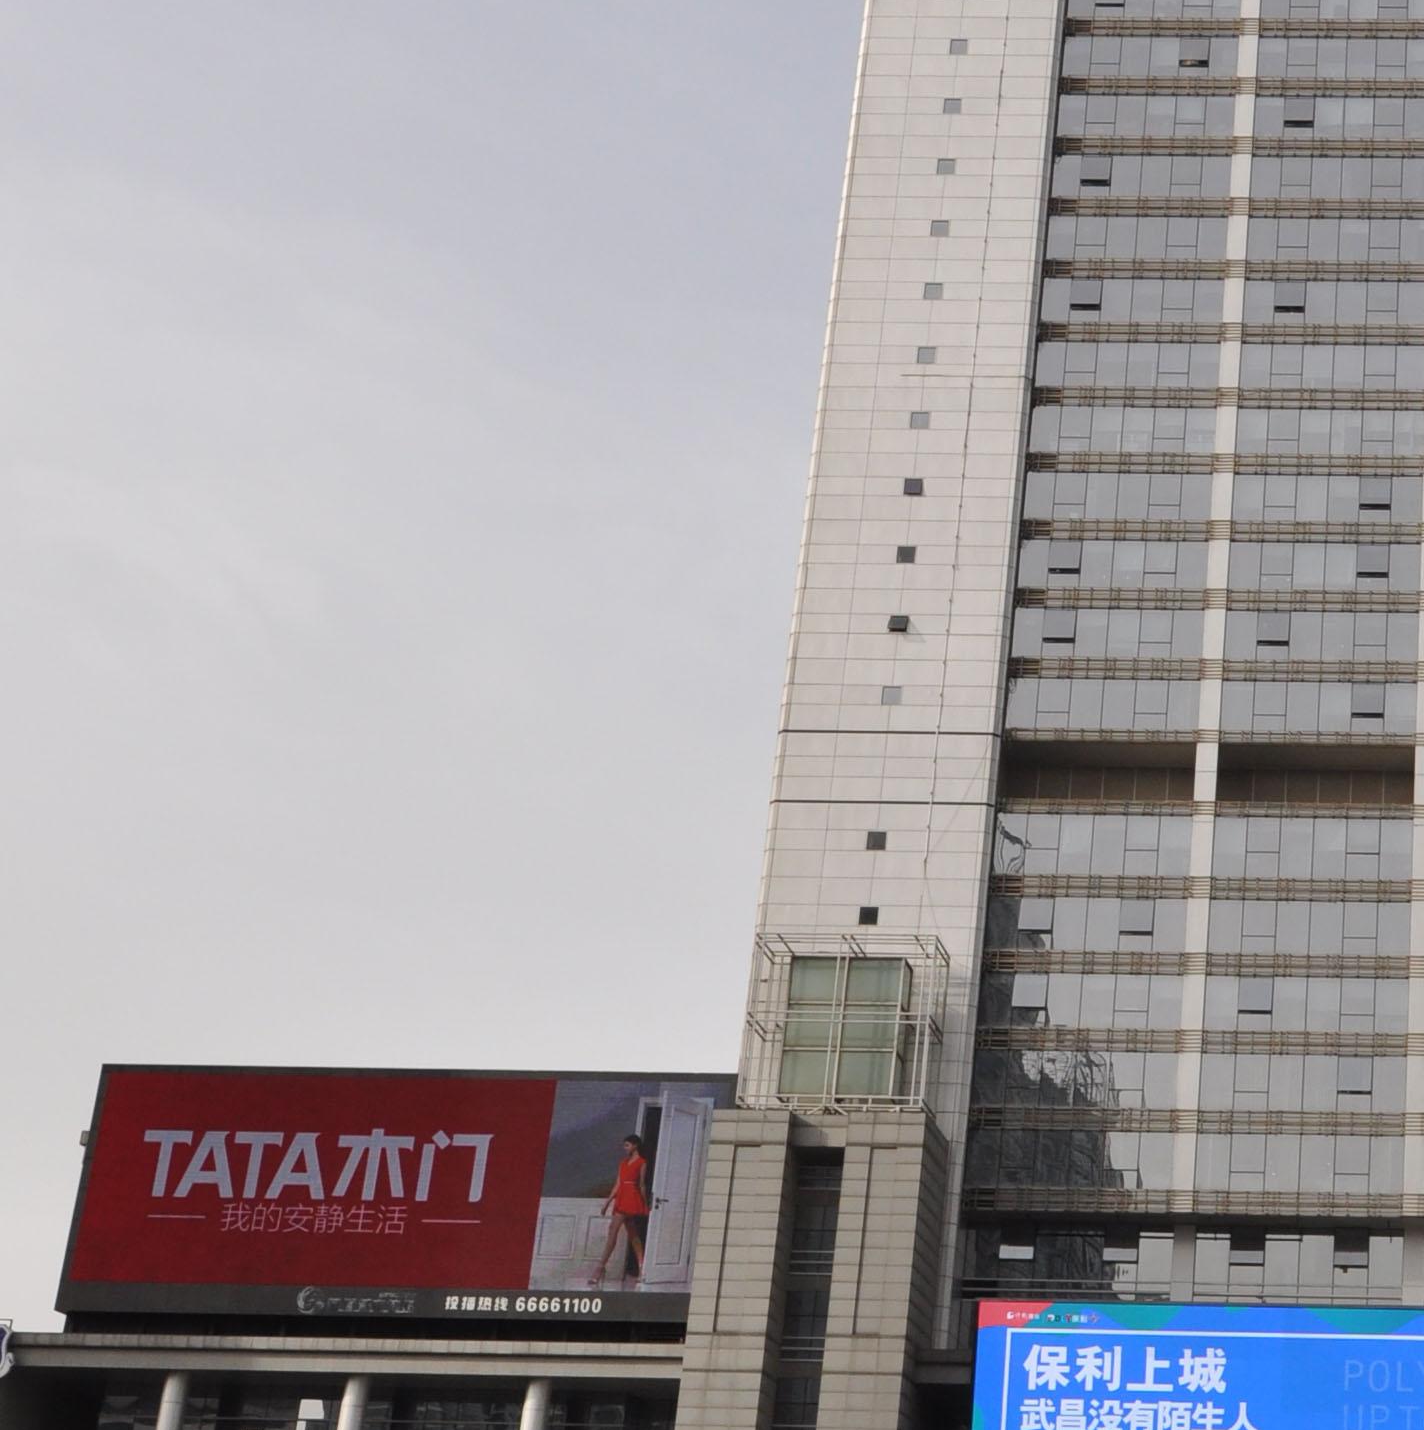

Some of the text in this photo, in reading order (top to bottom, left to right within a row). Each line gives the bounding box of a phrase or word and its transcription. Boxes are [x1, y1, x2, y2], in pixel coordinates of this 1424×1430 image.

[143, 1127, 495, 1203] TATA木门
[219, 1204, 409, 1235] 我的安静生活
[515, 1296, 602, 1314] 66661100
[1023, 1344, 1227, 1393] 保利上城
